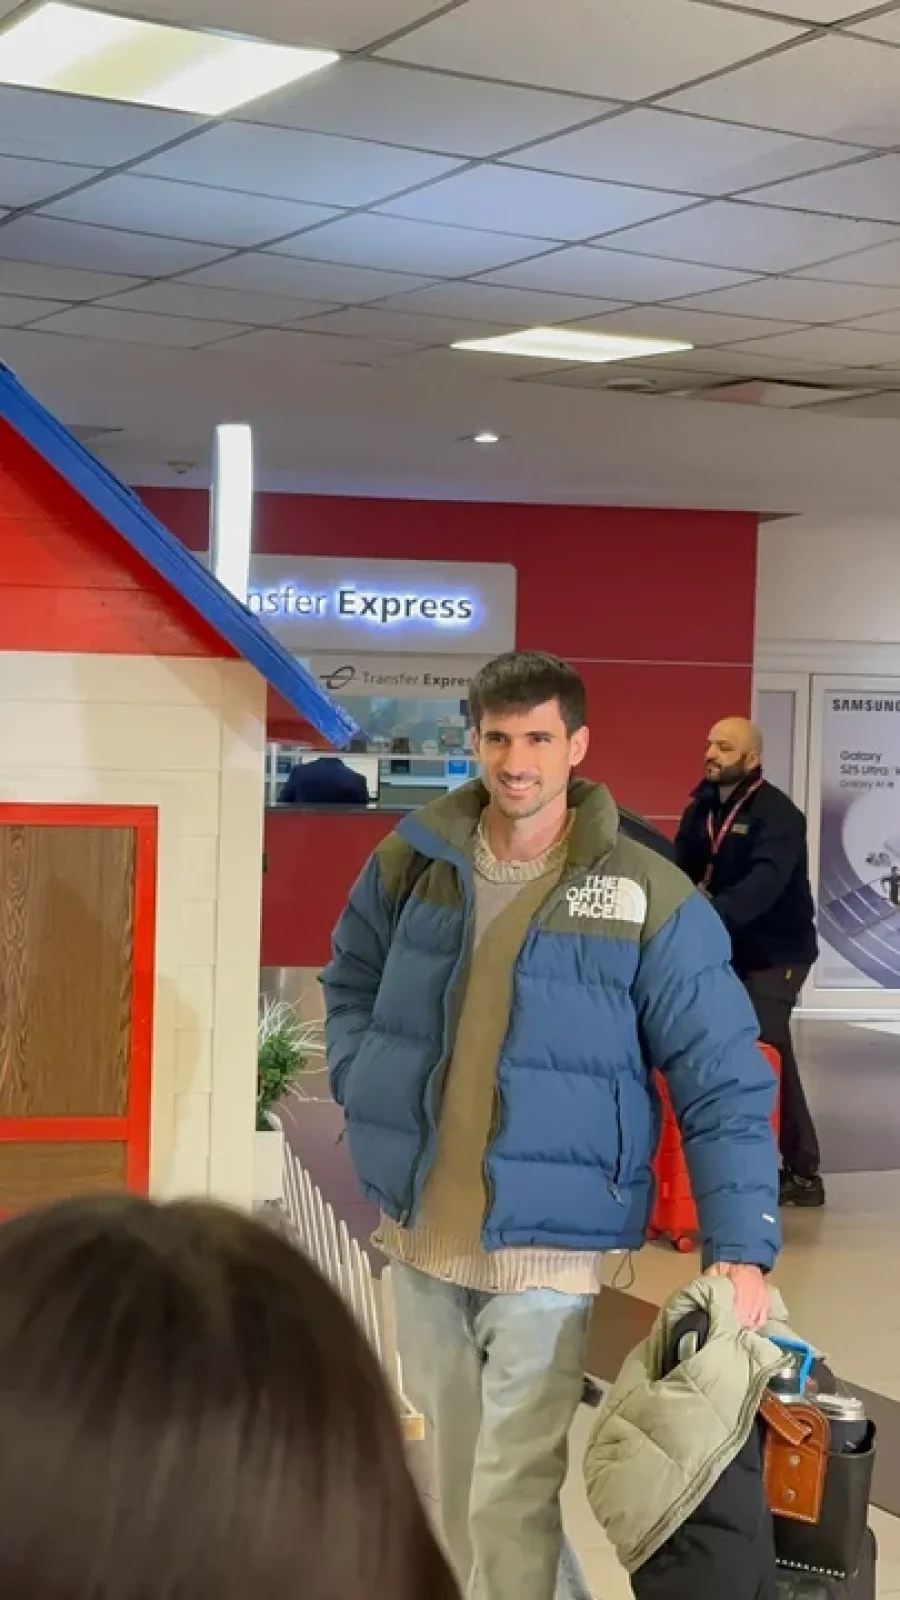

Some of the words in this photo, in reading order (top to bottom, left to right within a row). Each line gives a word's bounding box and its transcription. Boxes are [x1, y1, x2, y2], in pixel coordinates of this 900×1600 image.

[248, 586, 327, 614] nsfer
[339, 590, 472, 622] Express
[361, 671, 419, 686] Transfer
[424, 672, 472, 689] Expres
[840, 750, 882, 764] Galaxy
[586, 875, 619, 890] THE
[566, 886, 613, 904] ORTH
[569, 901, 616, 919] FACE
